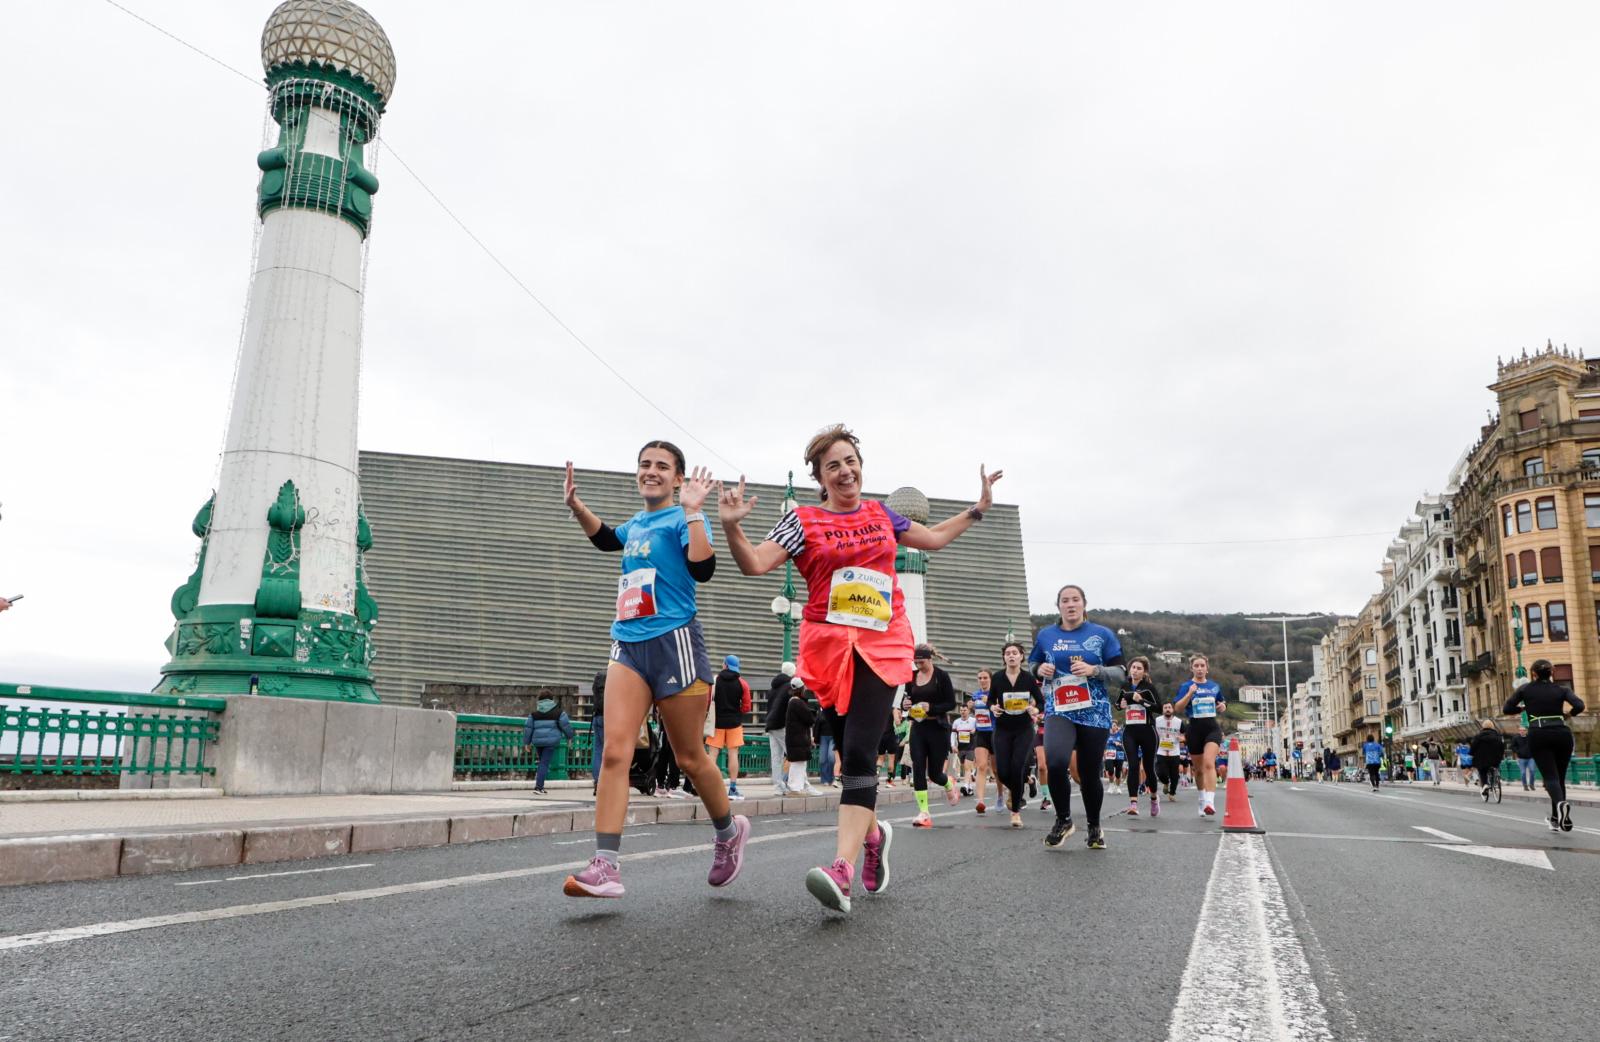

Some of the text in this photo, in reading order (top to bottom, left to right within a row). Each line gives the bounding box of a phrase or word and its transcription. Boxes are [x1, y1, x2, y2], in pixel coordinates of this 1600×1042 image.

[857, 573, 885, 587] ZURICH
[848, 594, 881, 607] AMAIA
[850, 605, 874, 616] 10762
[1065, 690, 1079, 698] LÉA
